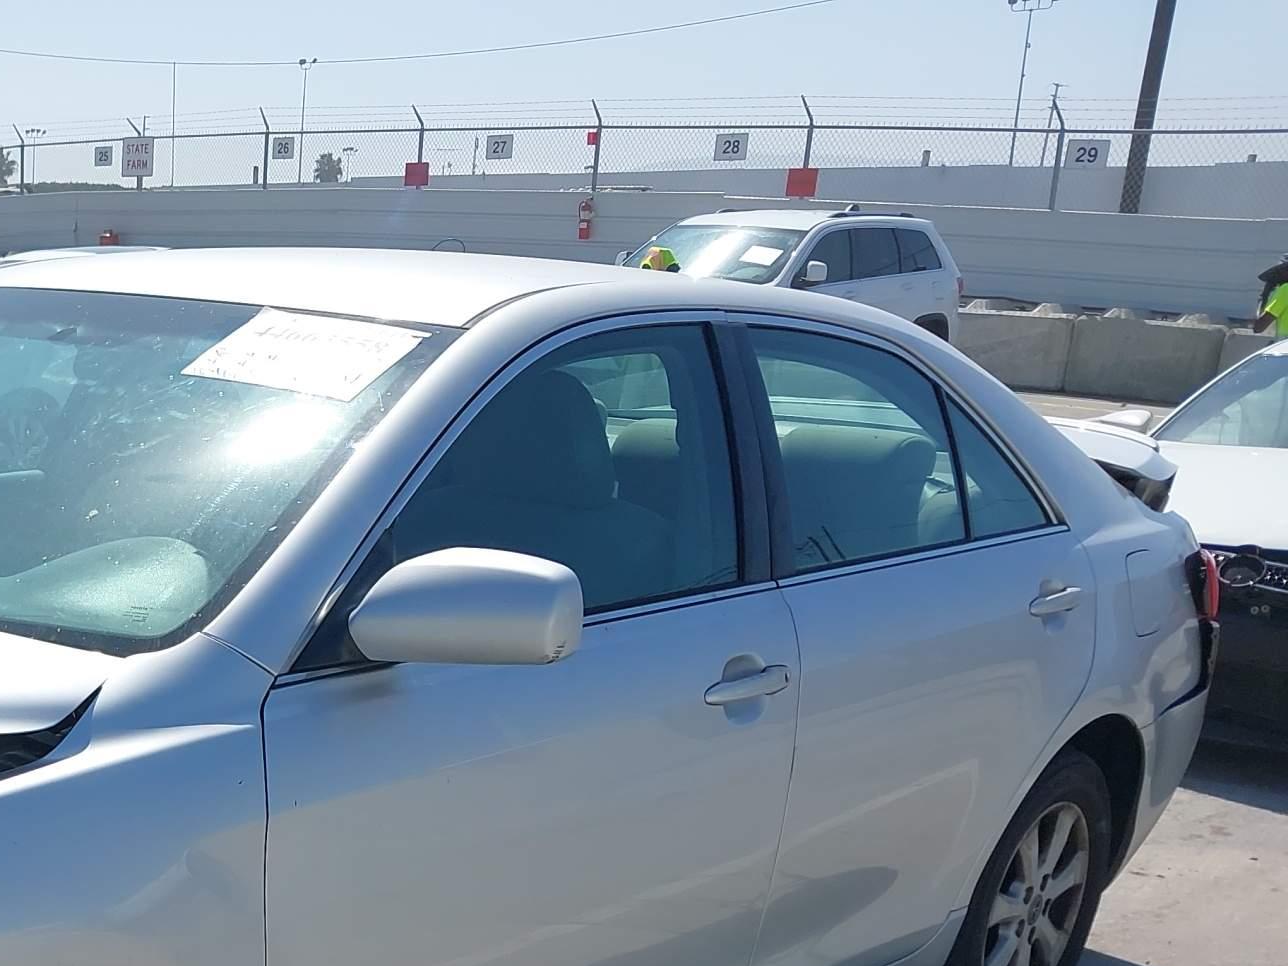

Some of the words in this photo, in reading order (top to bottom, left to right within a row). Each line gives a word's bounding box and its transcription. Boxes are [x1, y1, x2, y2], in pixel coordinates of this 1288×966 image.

[126, 143, 149, 155] STATE
[277, 142, 290, 154] 26
[493, 140, 507, 154] 27
[723, 140, 741, 154] 28
[98, 151, 109, 162] 25
[1075, 146, 1098, 164] 29
[126, 159, 148, 170] FARM
